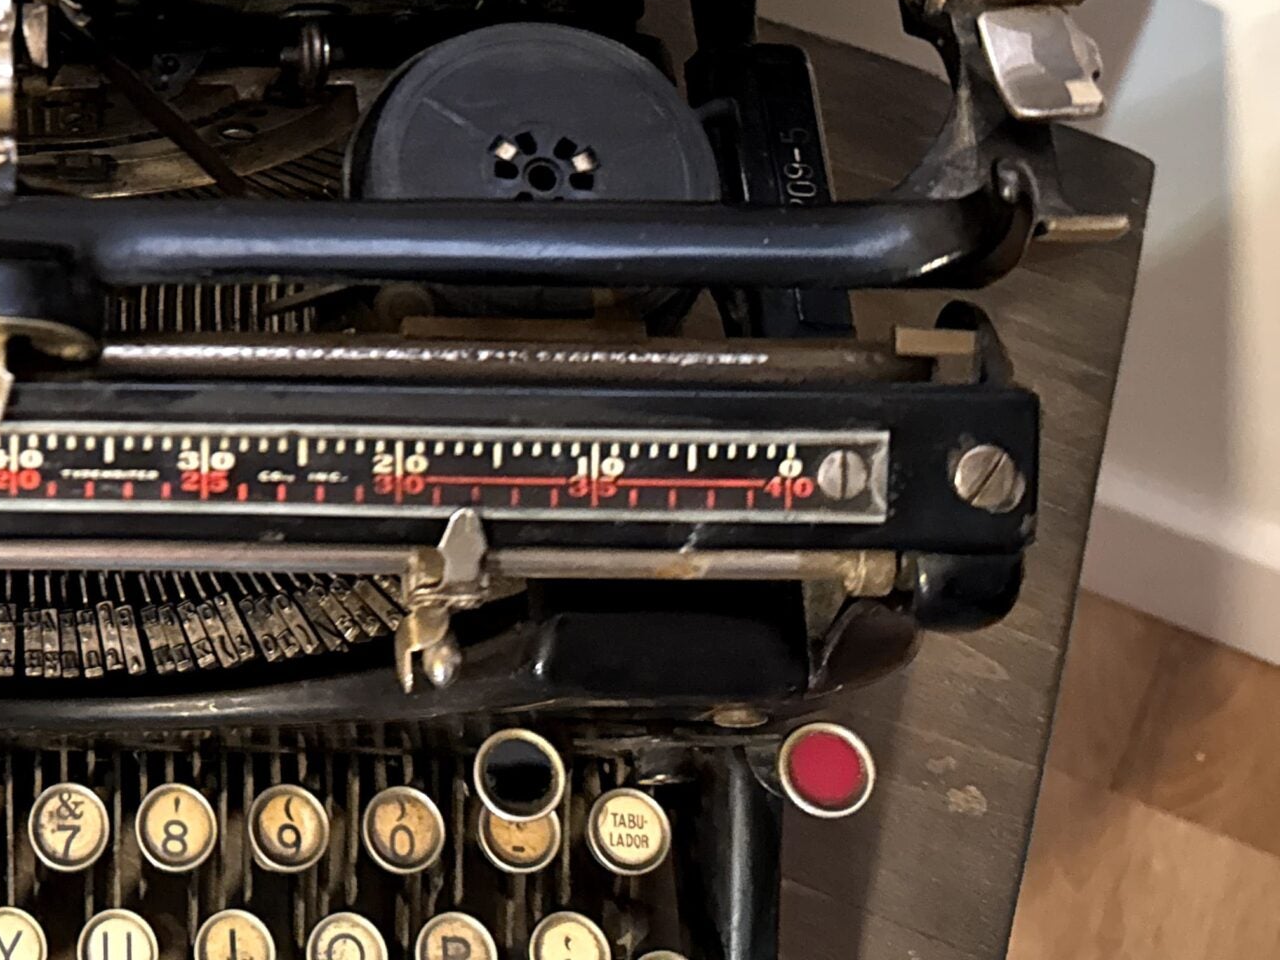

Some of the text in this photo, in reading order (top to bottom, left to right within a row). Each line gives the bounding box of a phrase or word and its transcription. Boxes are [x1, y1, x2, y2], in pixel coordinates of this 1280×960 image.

[177, 451, 235, 471] 30
[373, 453, 428, 474] 20
[181, 471, 228, 493] 25
[374, 474, 425, 495] 30
[568, 476, 617, 498] 35
[765, 476, 814, 499] 40
[56, 823, 82, 860] 7
[160, 819, 190, 858] 8
[277, 822, 302, 858] 9
[389, 823, 416, 858] 0
[609, 831, 650, 849] LADOR
